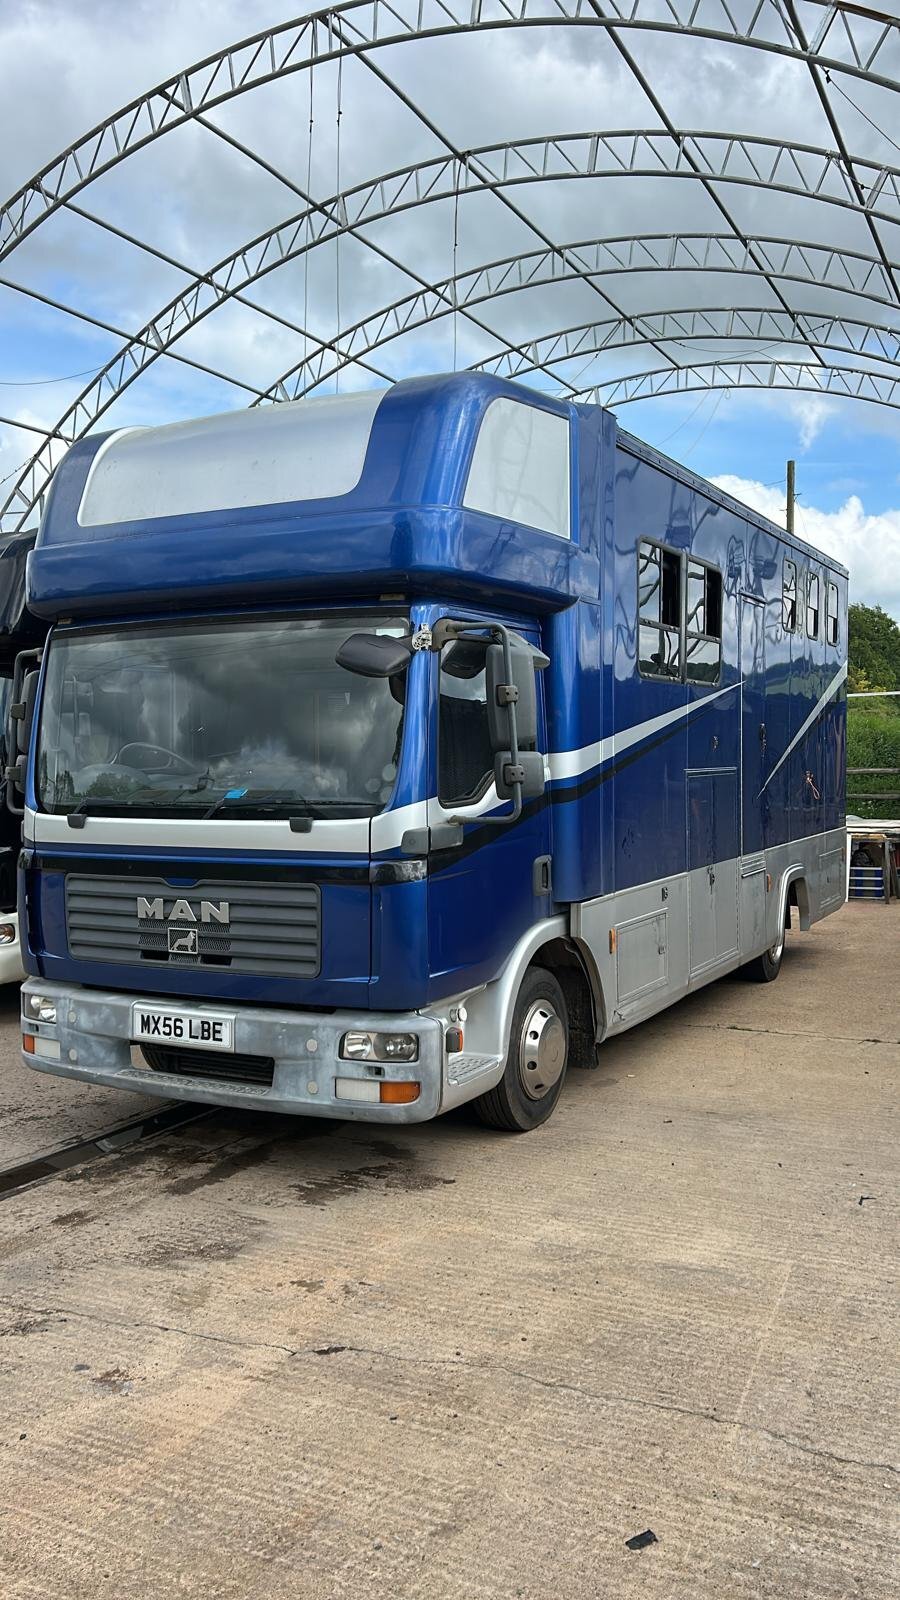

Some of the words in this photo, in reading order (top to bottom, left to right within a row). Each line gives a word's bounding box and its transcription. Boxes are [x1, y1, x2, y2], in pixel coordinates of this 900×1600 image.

[137, 897, 230, 923] MAN
[140, 1014, 184, 1038] MX56
[188, 1019, 223, 1042] LBE
